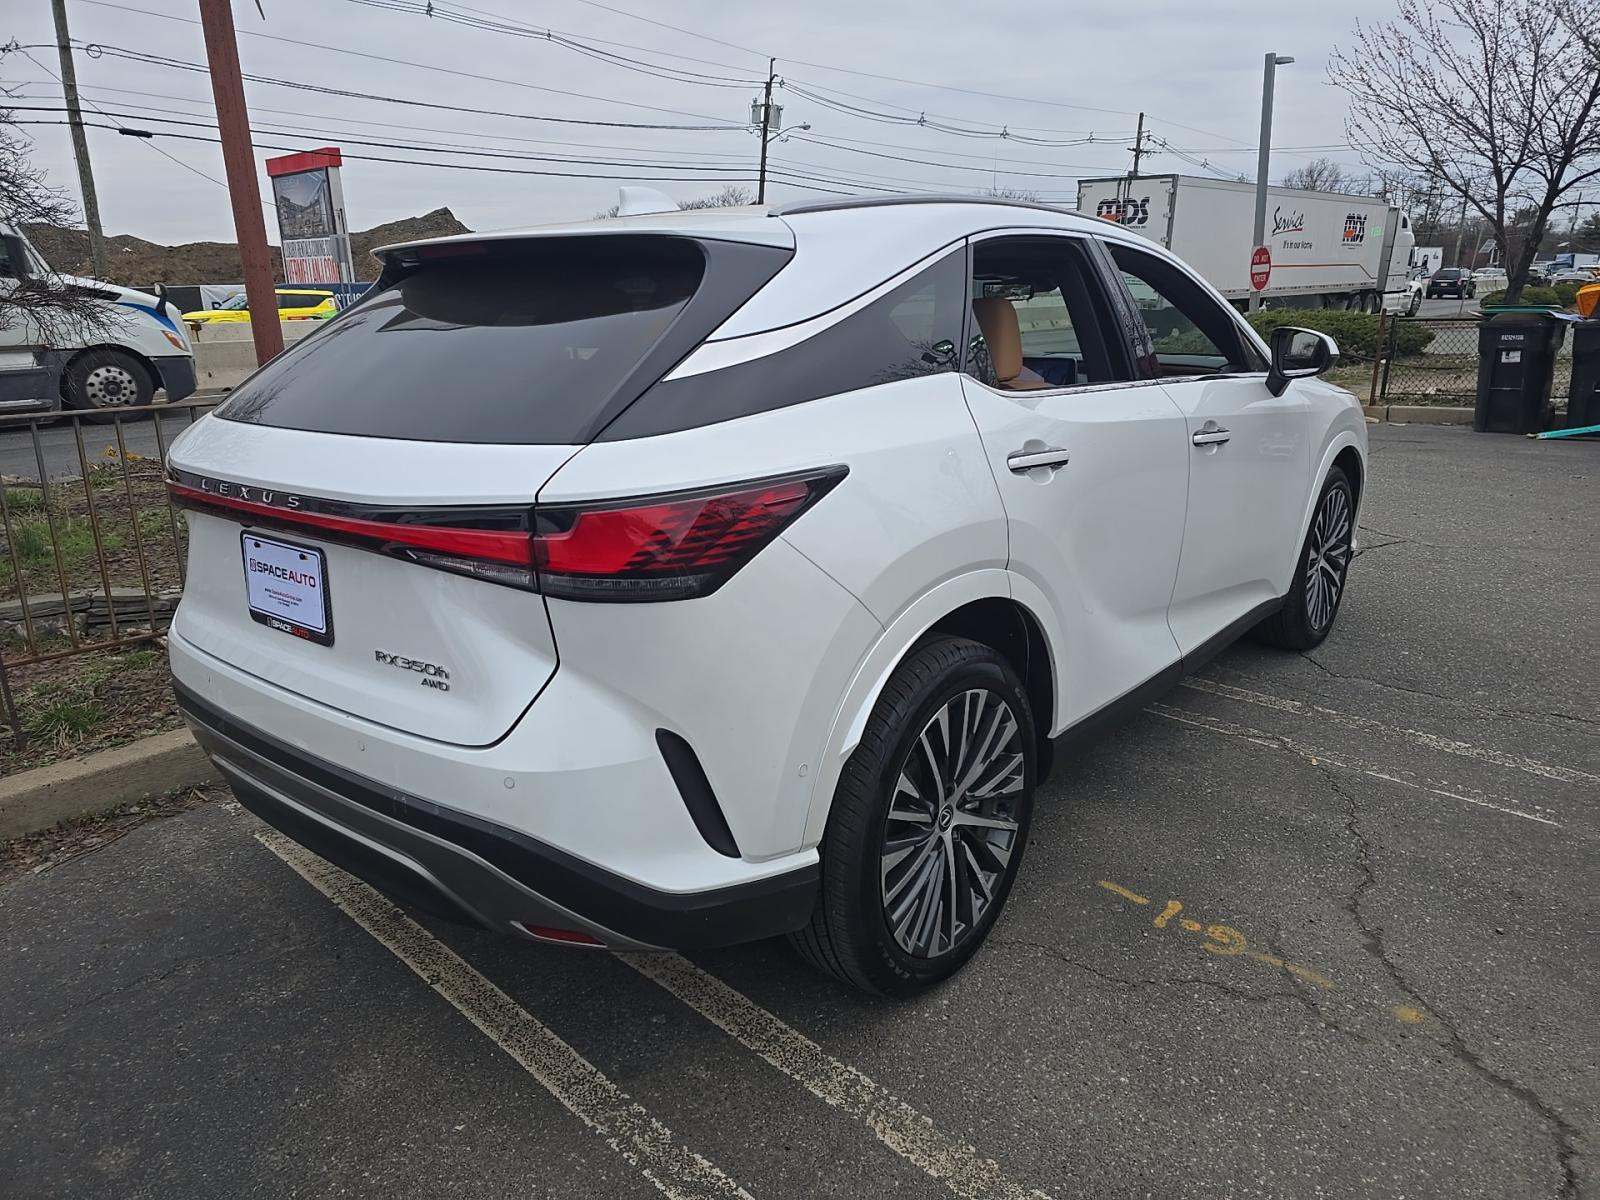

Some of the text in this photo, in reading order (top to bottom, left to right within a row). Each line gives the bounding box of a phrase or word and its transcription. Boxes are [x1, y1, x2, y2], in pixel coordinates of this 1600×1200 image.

[1254, 254, 1270, 263] DO NOT
[1253, 274, 1267, 283] ENTER
[201, 478, 300, 508] LEXUS
[256, 561, 317, 588] SPACEAUTO
[420, 678, 450, 692] AWD
